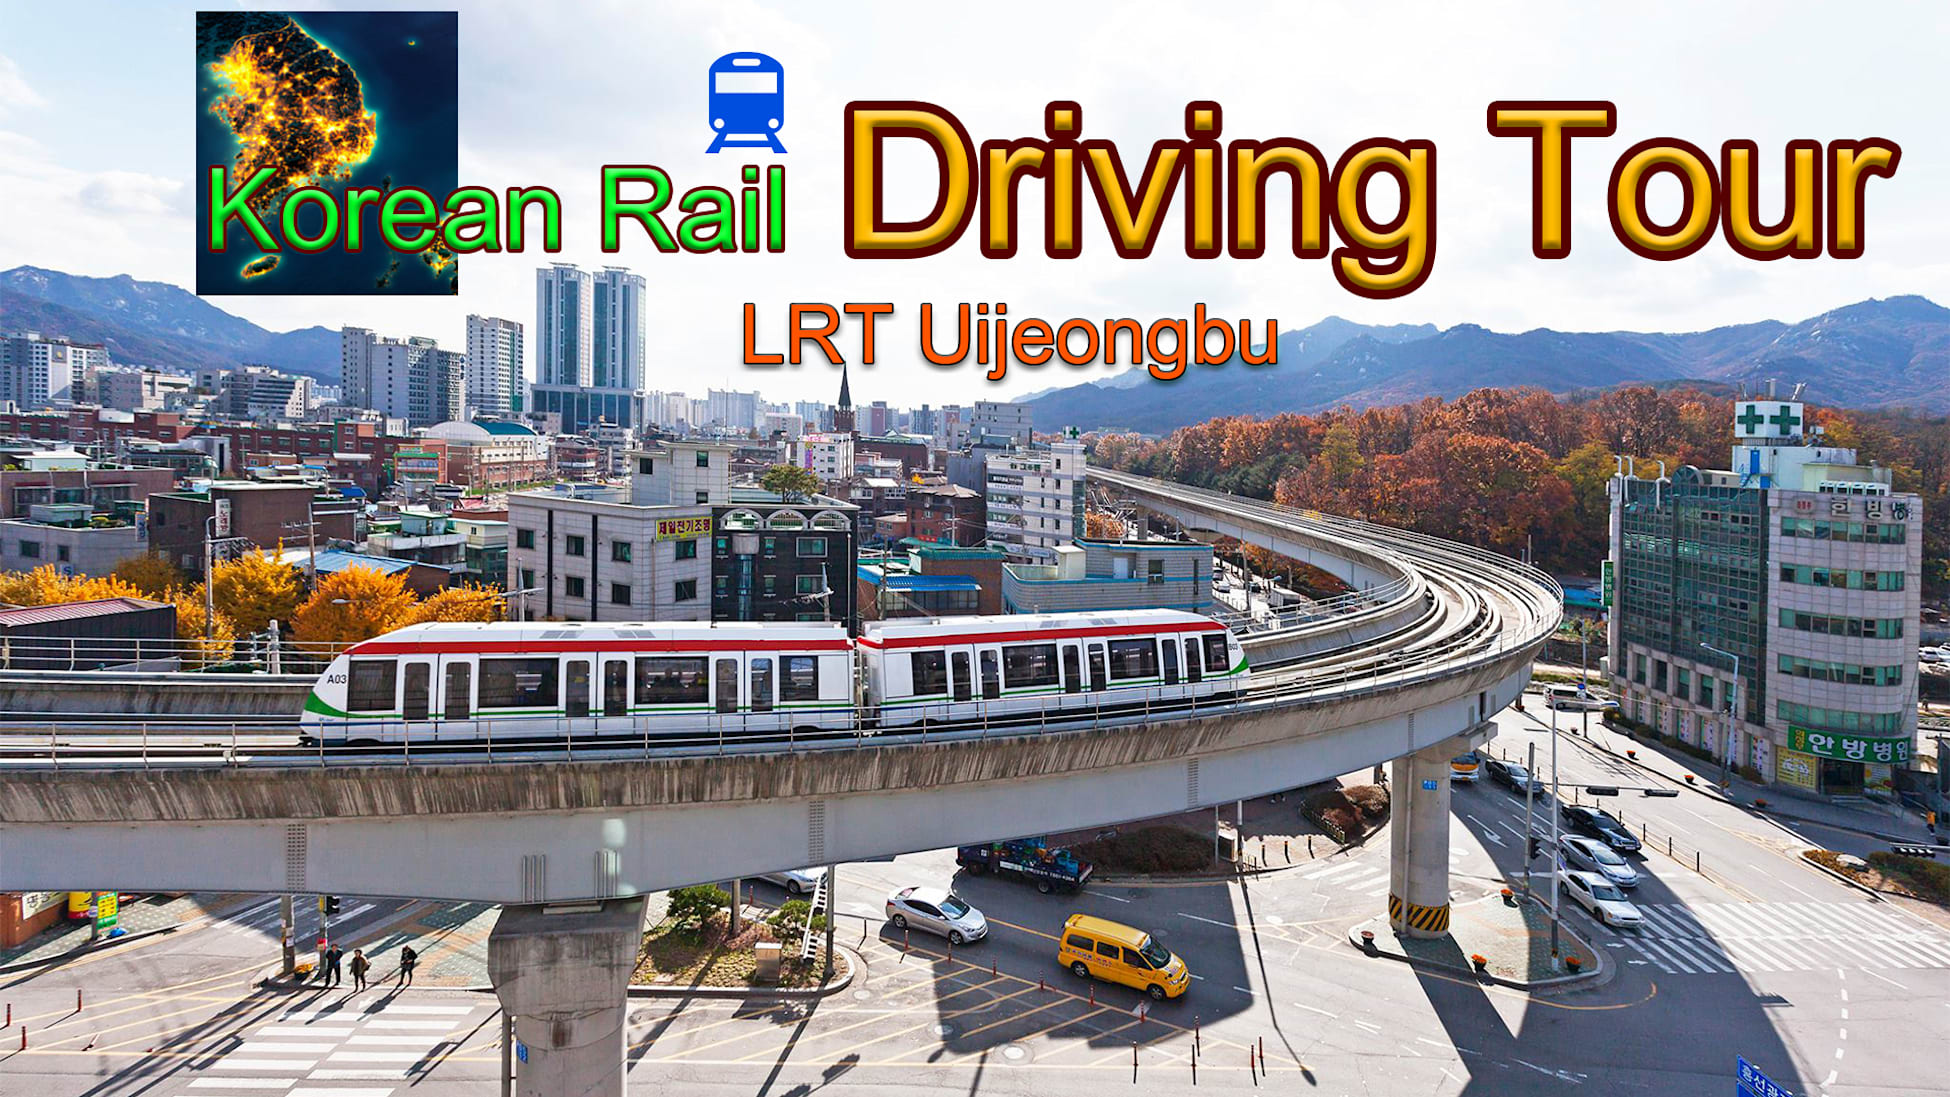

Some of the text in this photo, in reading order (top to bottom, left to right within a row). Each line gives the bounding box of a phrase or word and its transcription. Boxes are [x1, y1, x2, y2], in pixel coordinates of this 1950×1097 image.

[658, 518, 711, 535] 제일전기조명
[327, 674, 347, 684] A03
[1808, 733, 1908, 762] 안방병원
[1742, 1064, 1786, 1097] 흥선광
